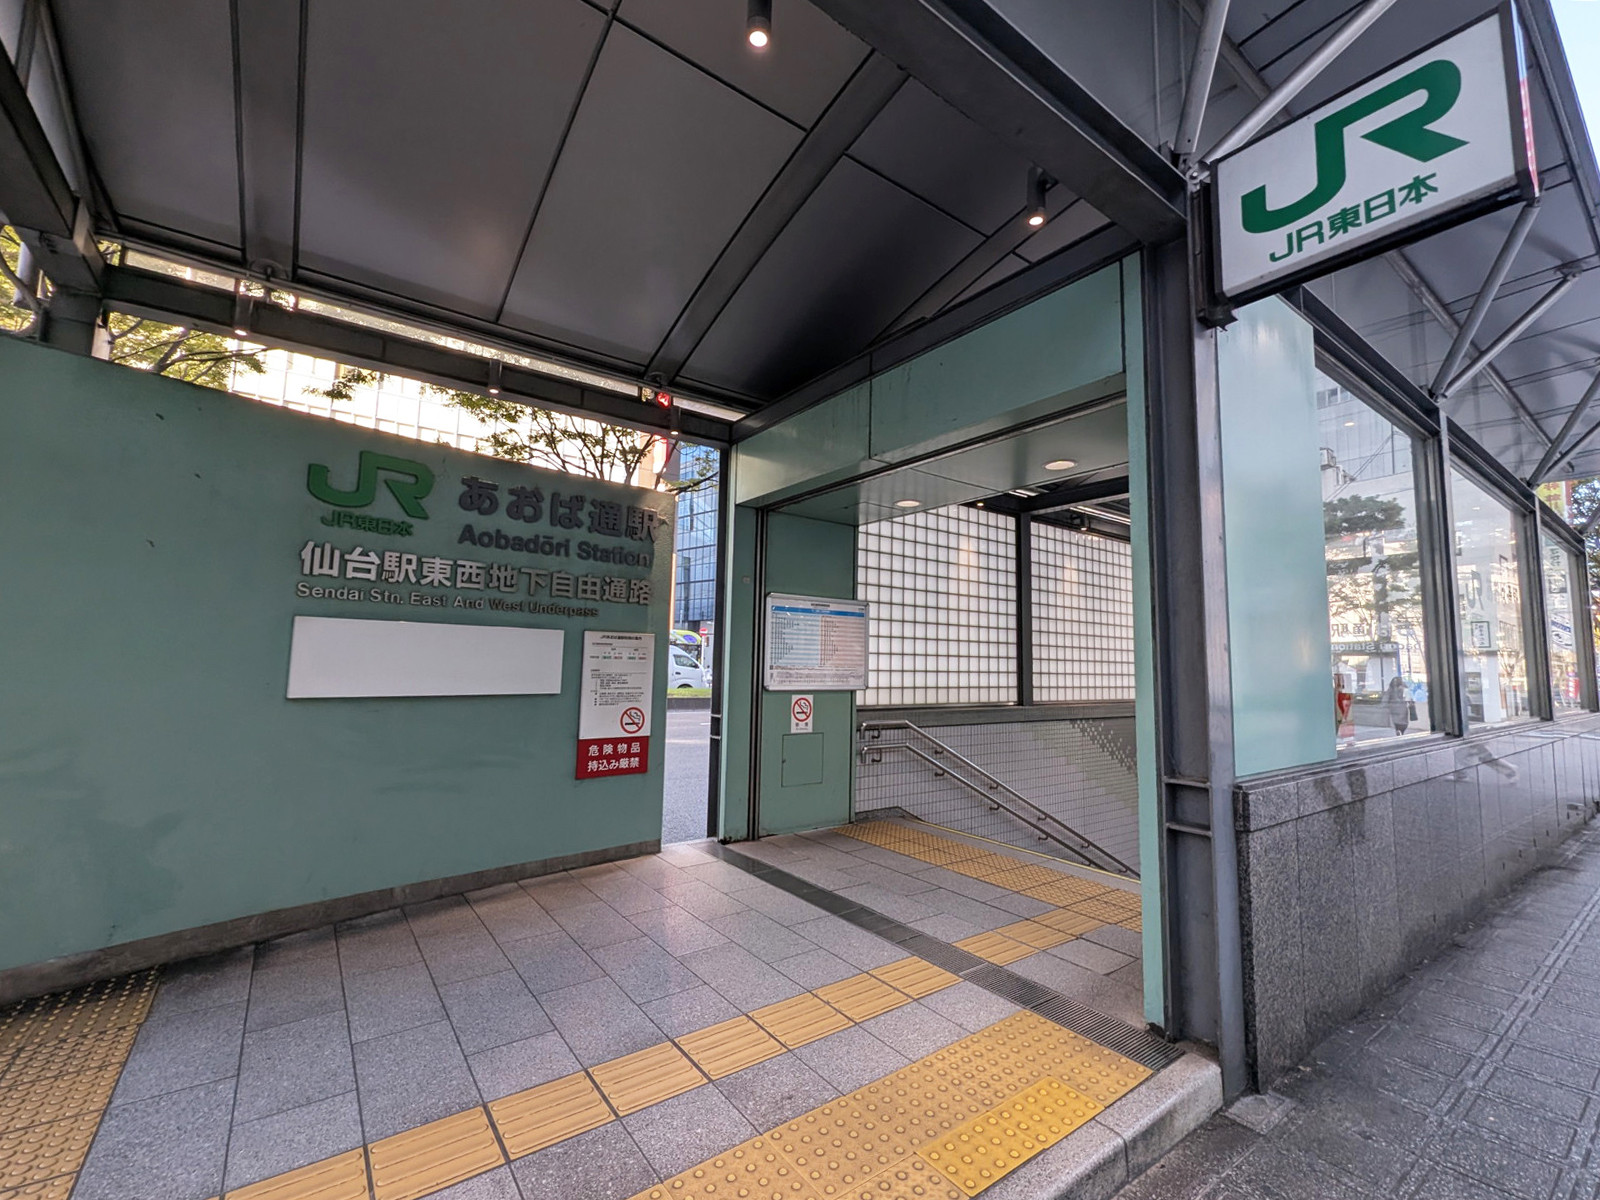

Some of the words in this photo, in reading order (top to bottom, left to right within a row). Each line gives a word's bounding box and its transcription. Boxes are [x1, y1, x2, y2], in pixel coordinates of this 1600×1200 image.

[1241, 59, 1470, 233] JR
[1269, 173, 1438, 262] JR東日本
[307, 450, 434, 520] JR
[458, 476, 660, 543] あおば通駅
[321, 510, 414, 537] JR東日本
[458, 524, 570, 557] Aobadōri
[577, 540, 651, 568] Station
[297, 582, 364, 601] Sendai
[370, 588, 404, 604] Stn.
[410, 592, 448, 607] East
[454, 596, 484, 610] And
[489, 598, 524, 613] West
[530, 601, 600, 618] Underpass
[301, 541, 651, 605] 仙台駅東西地下自由通路
[587, 757, 640, 772] 持込み厳禁
[588, 742, 641, 756] 危険物品
